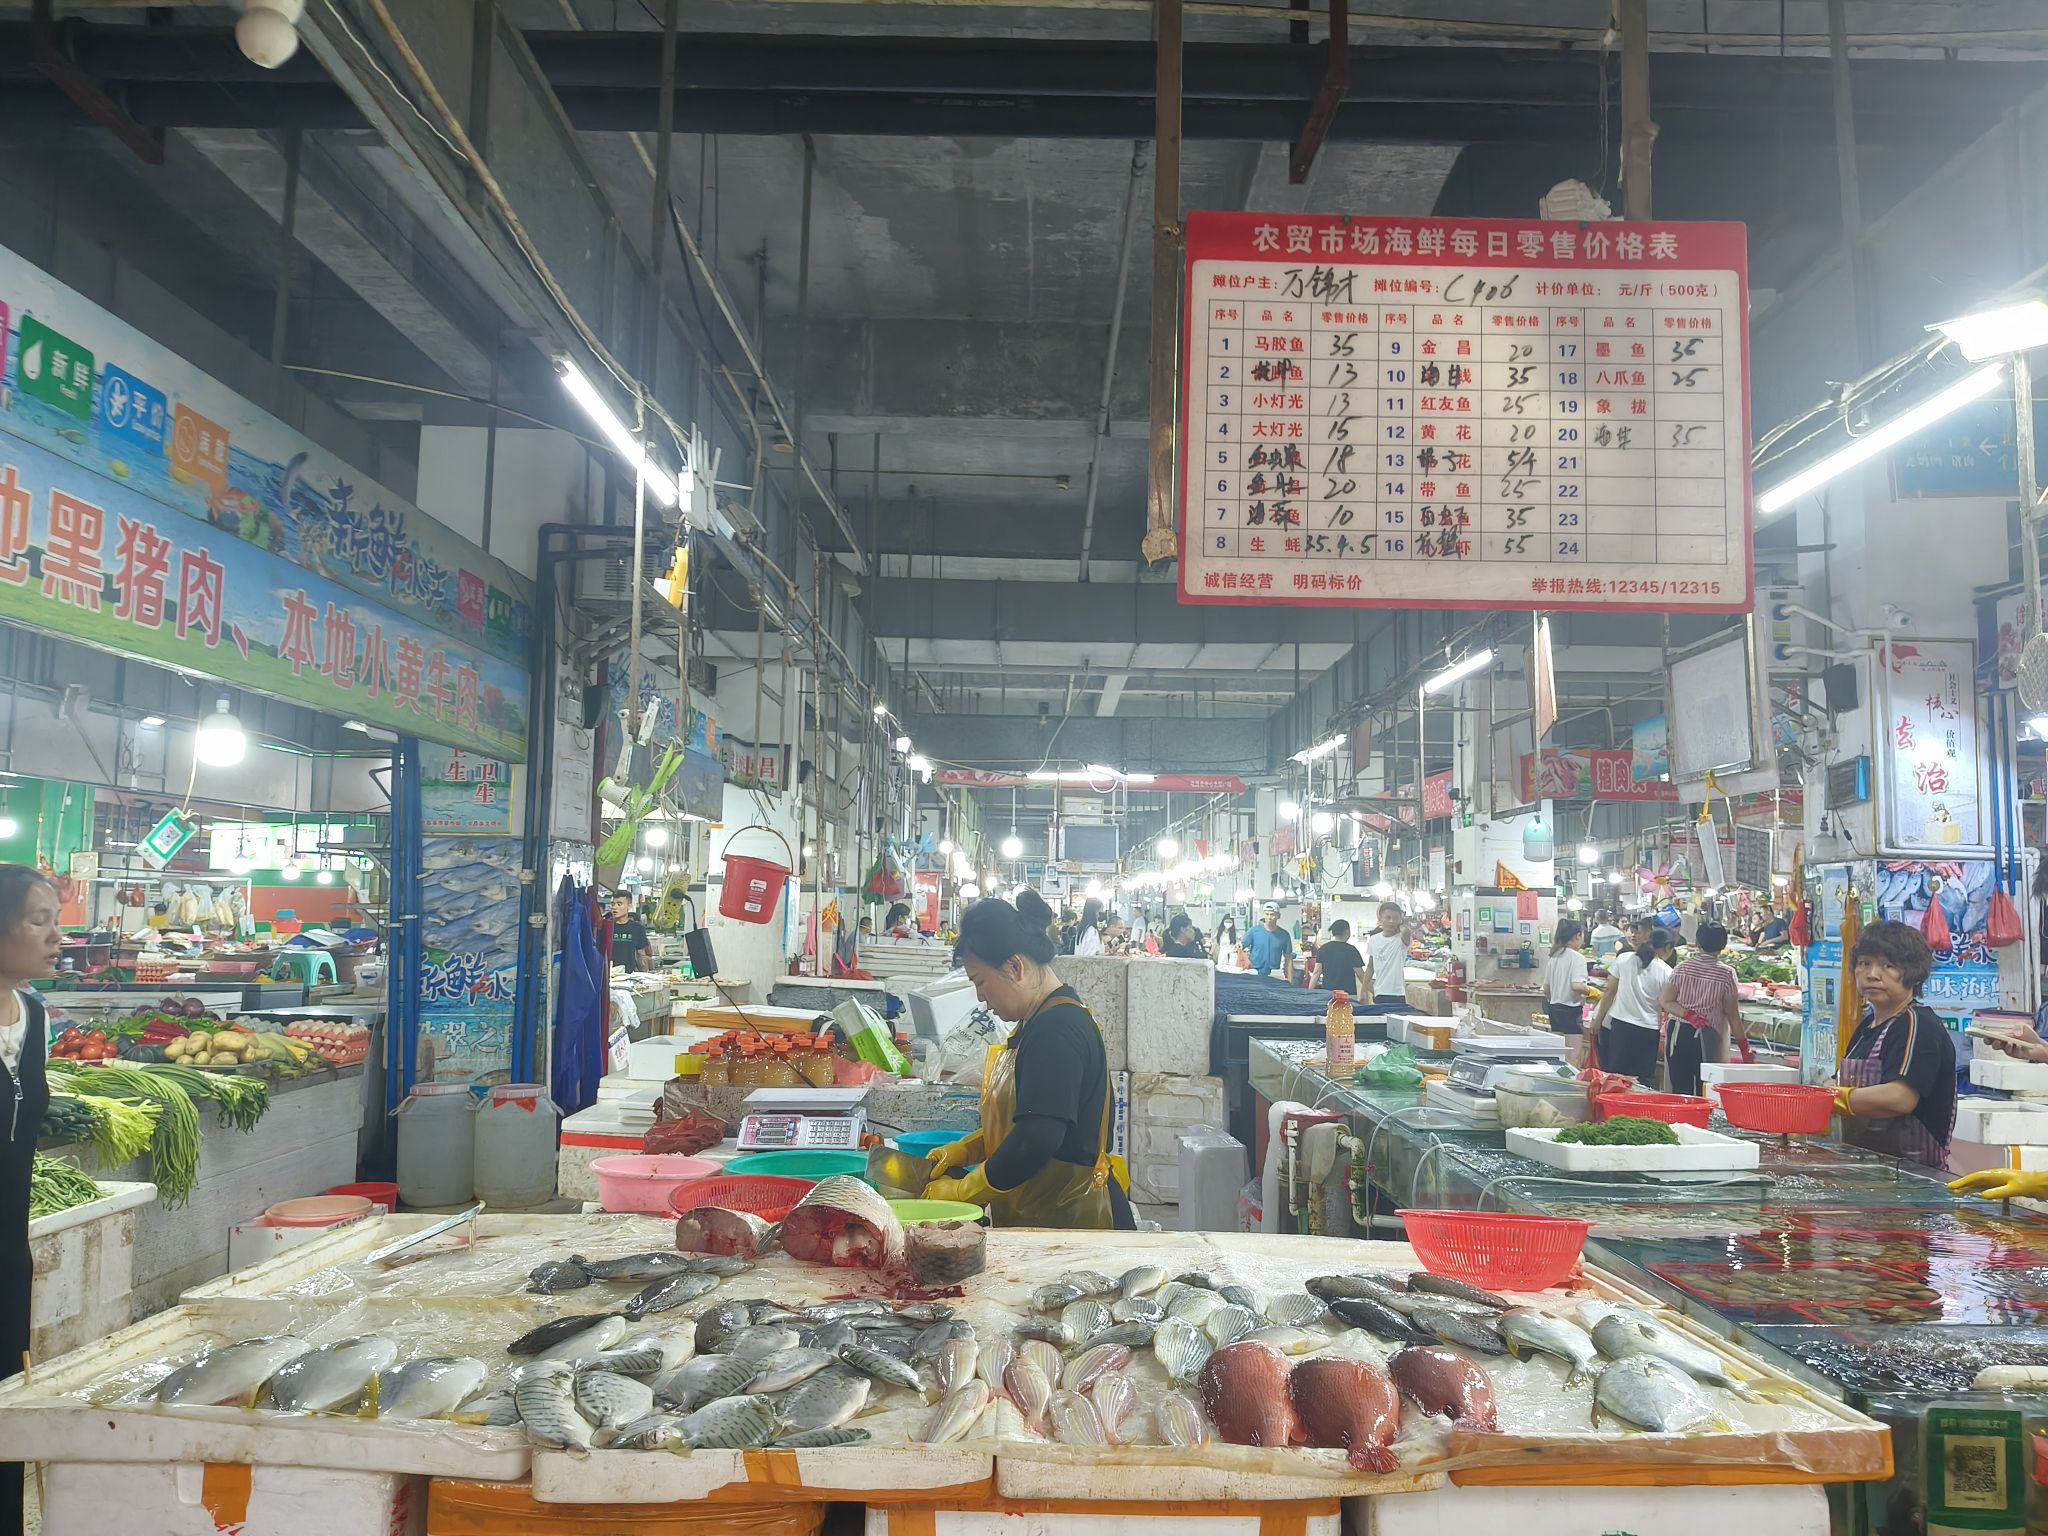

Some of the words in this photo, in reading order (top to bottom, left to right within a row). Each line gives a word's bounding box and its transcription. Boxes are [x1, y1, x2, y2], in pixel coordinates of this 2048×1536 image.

[1252, 223, 1679, 260] 农贸市场海鲜每日零售价格表
[1215, 309, 1238, 321] 序号
[1321, 311, 1369, 325] 零售价格
[1385, 313, 1408, 325] 序号
[1491, 315, 1540, 328] 零售价格
[1556, 316, 1579, 328] 序号
[1663, 317, 1712, 329] 零售价格
[1222, 337, 1229, 350] 1
[1254, 336, 1304, 352] 马胶鱼
[1329, 333, 1358, 356] 35
[1391, 342, 1400, 355] 9
[1421, 339, 1471, 355] 金昌
[1508, 344, 1533, 362] 20
[1558, 344, 1577, 357] 17
[1220, 366, 1229, 379] 2
[1328, 363, 1358, 388] 13
[1387, 370, 1406, 382] 10
[1507, 366, 1537, 388] 35
[1559, 372, 1577, 385] 18
[1596, 370, 1646, 386] 八爪鱼
[1671, 368, 1709, 387] 25
[1219, 394, 1229, 407] 3
[1253, 393, 1304, 409] 小灯光
[1327, 393, 1350, 416] 13
[1387, 398, 1404, 411] 11
[1421, 396, 1471, 412] 红友鱼
[1502, 393, 1540, 415] 25
[1559, 401, 1577, 413] 19
[1219, 423, 1228, 436] 4
[1252, 421, 1303, 437] 大灯光
[1328, 416, 1363, 441] 15
[1386, 426, 1405, 439] 12
[1421, 424, 1471, 440] 黄花
[1510, 424, 1536, 443] 20
[1558, 428, 1577, 441] 20
[1218, 451, 1228, 464] 5
[1323, 444, 1356, 478] 18
[1386, 454, 1404, 467] 13
[1558, 456, 1577, 469] 21
[1218, 480, 1227, 492] 6
[1324, 478, 1356, 500] 20
[1385, 483, 1404, 495] 14
[1420, 481, 1471, 498] 带鱼
[1501, 479, 1541, 499] 25
[1558, 485, 1578, 497] 22
[1217, 508, 1226, 521] 7
[1328, 504, 1354, 528] 10
[1385, 511, 1404, 524] 15
[1507, 507, 1535, 529] 35
[1558, 514, 1578, 526] 23
[1216, 537, 1226, 549] 8
[1251, 536, 1301, 552] 生蚝
[1385, 539, 1404, 552] 16
[1504, 535, 1534, 554] 55
[1558, 542, 1579, 555] 24
[1204, 572, 1273, 590] 诚信经营
[1293, 573, 1362, 591] 明码标价
[1532, 577, 1720, 595] 举报热线:12345/12315
